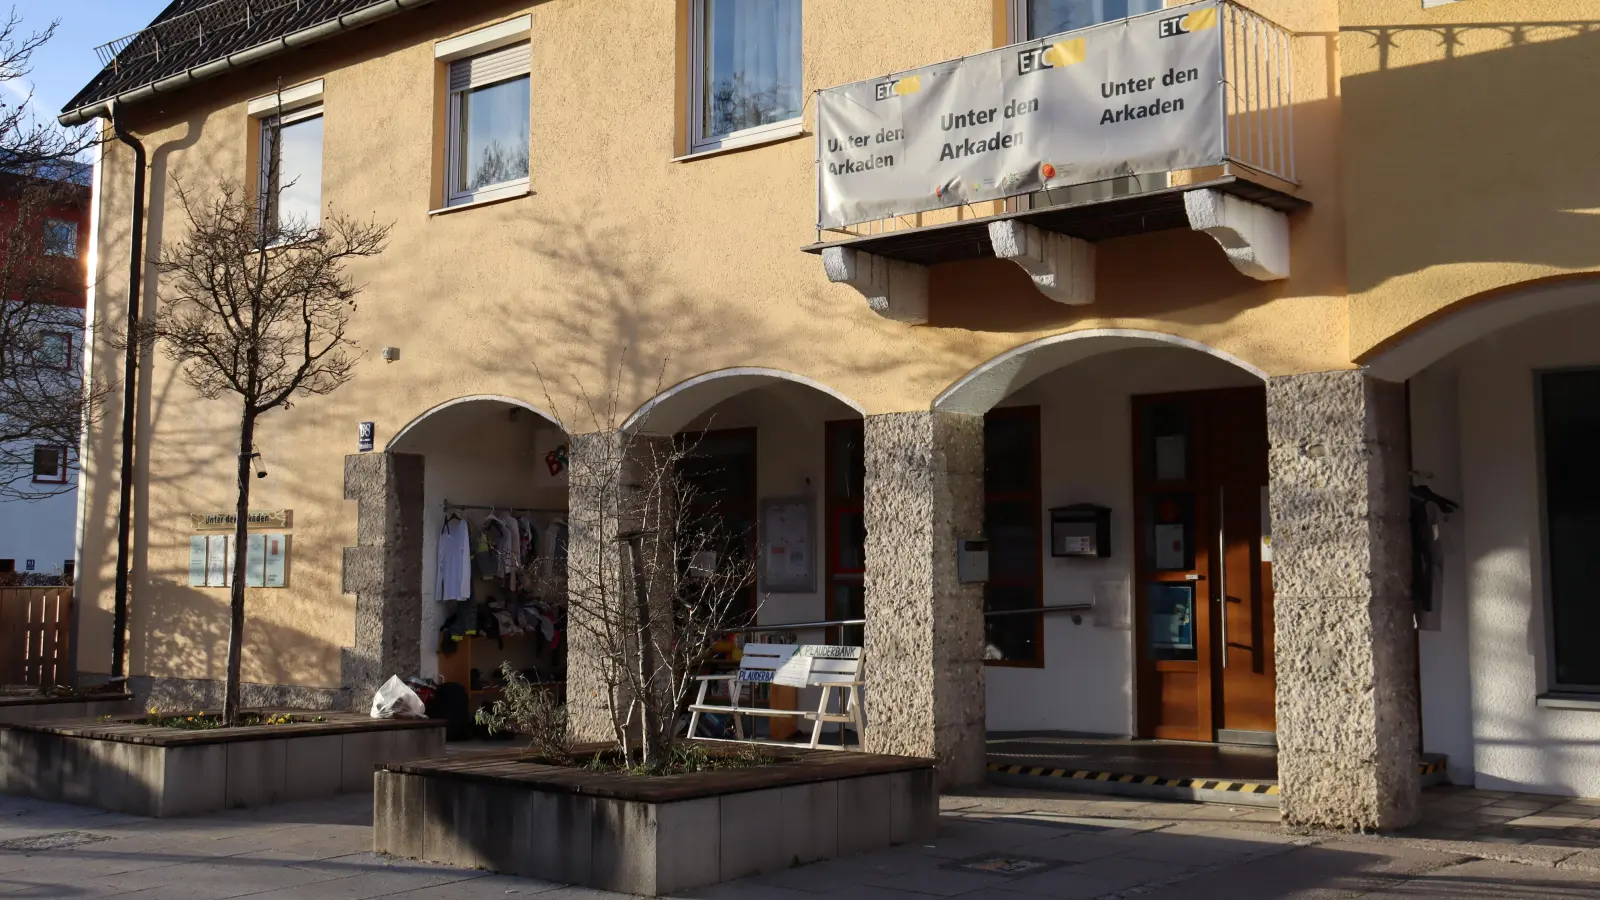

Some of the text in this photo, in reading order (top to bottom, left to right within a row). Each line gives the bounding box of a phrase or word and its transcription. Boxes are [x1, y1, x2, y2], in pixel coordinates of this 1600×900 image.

[1101, 67, 1199, 99] Unter den
[941, 97, 1039, 132] Unter den
[1100, 97, 1185, 125] Arkaden
[828, 127, 905, 153] Unter den
[939, 131, 1024, 162] Arkaden
[828, 154, 894, 176] Arkaden
[805, 646, 856, 658] PLAUDERBANK
